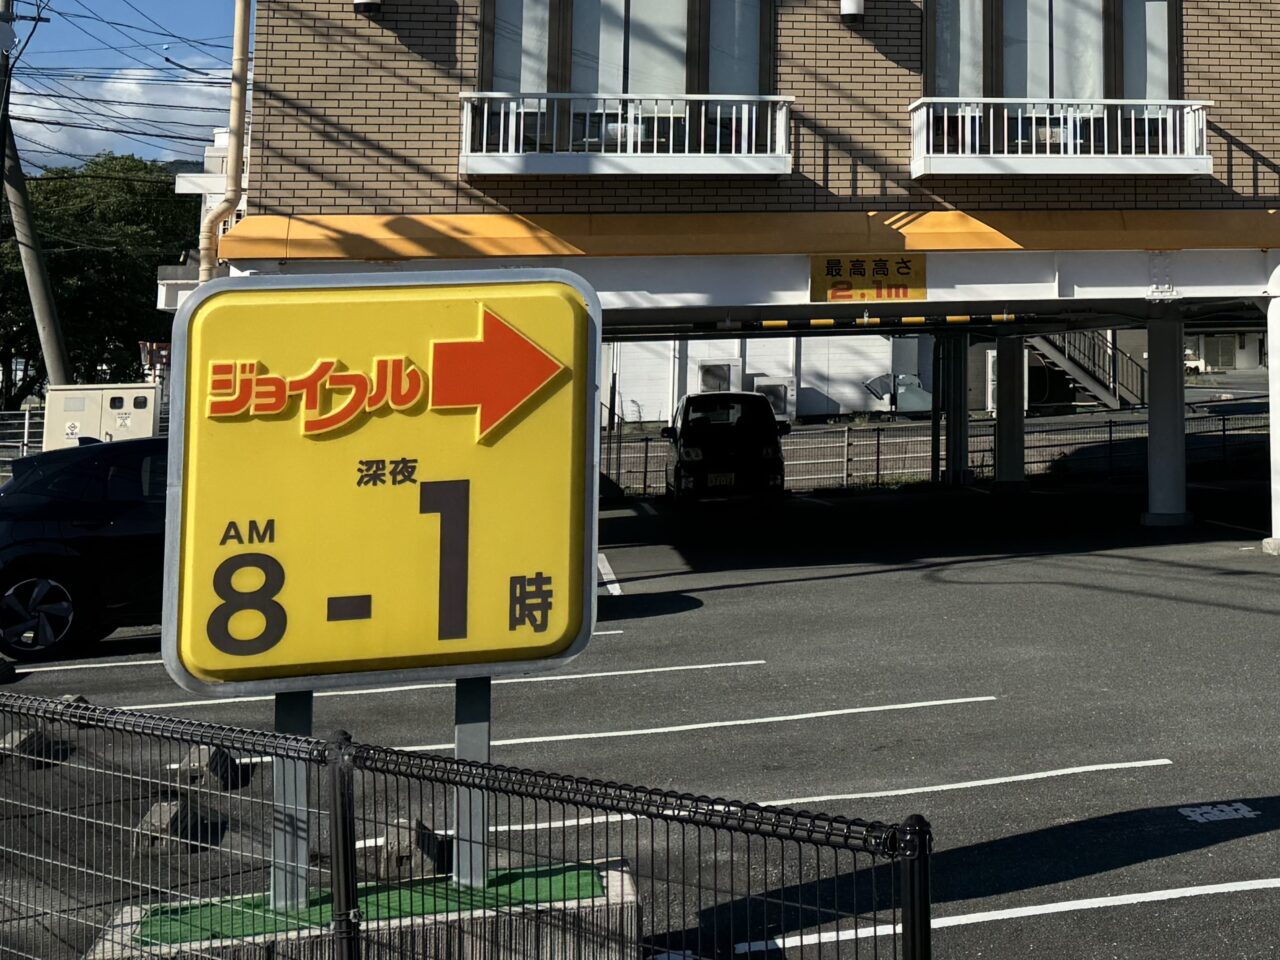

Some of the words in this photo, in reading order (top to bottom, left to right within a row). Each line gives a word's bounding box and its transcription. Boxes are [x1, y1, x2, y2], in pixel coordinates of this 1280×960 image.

[825, 258, 912, 277] 最高高さ
[830, 280, 909, 300] 2.1m
[206, 356, 425, 436] ジョイフル
[356, 458, 418, 487] 深夜
[219, 519, 276, 546] AM
